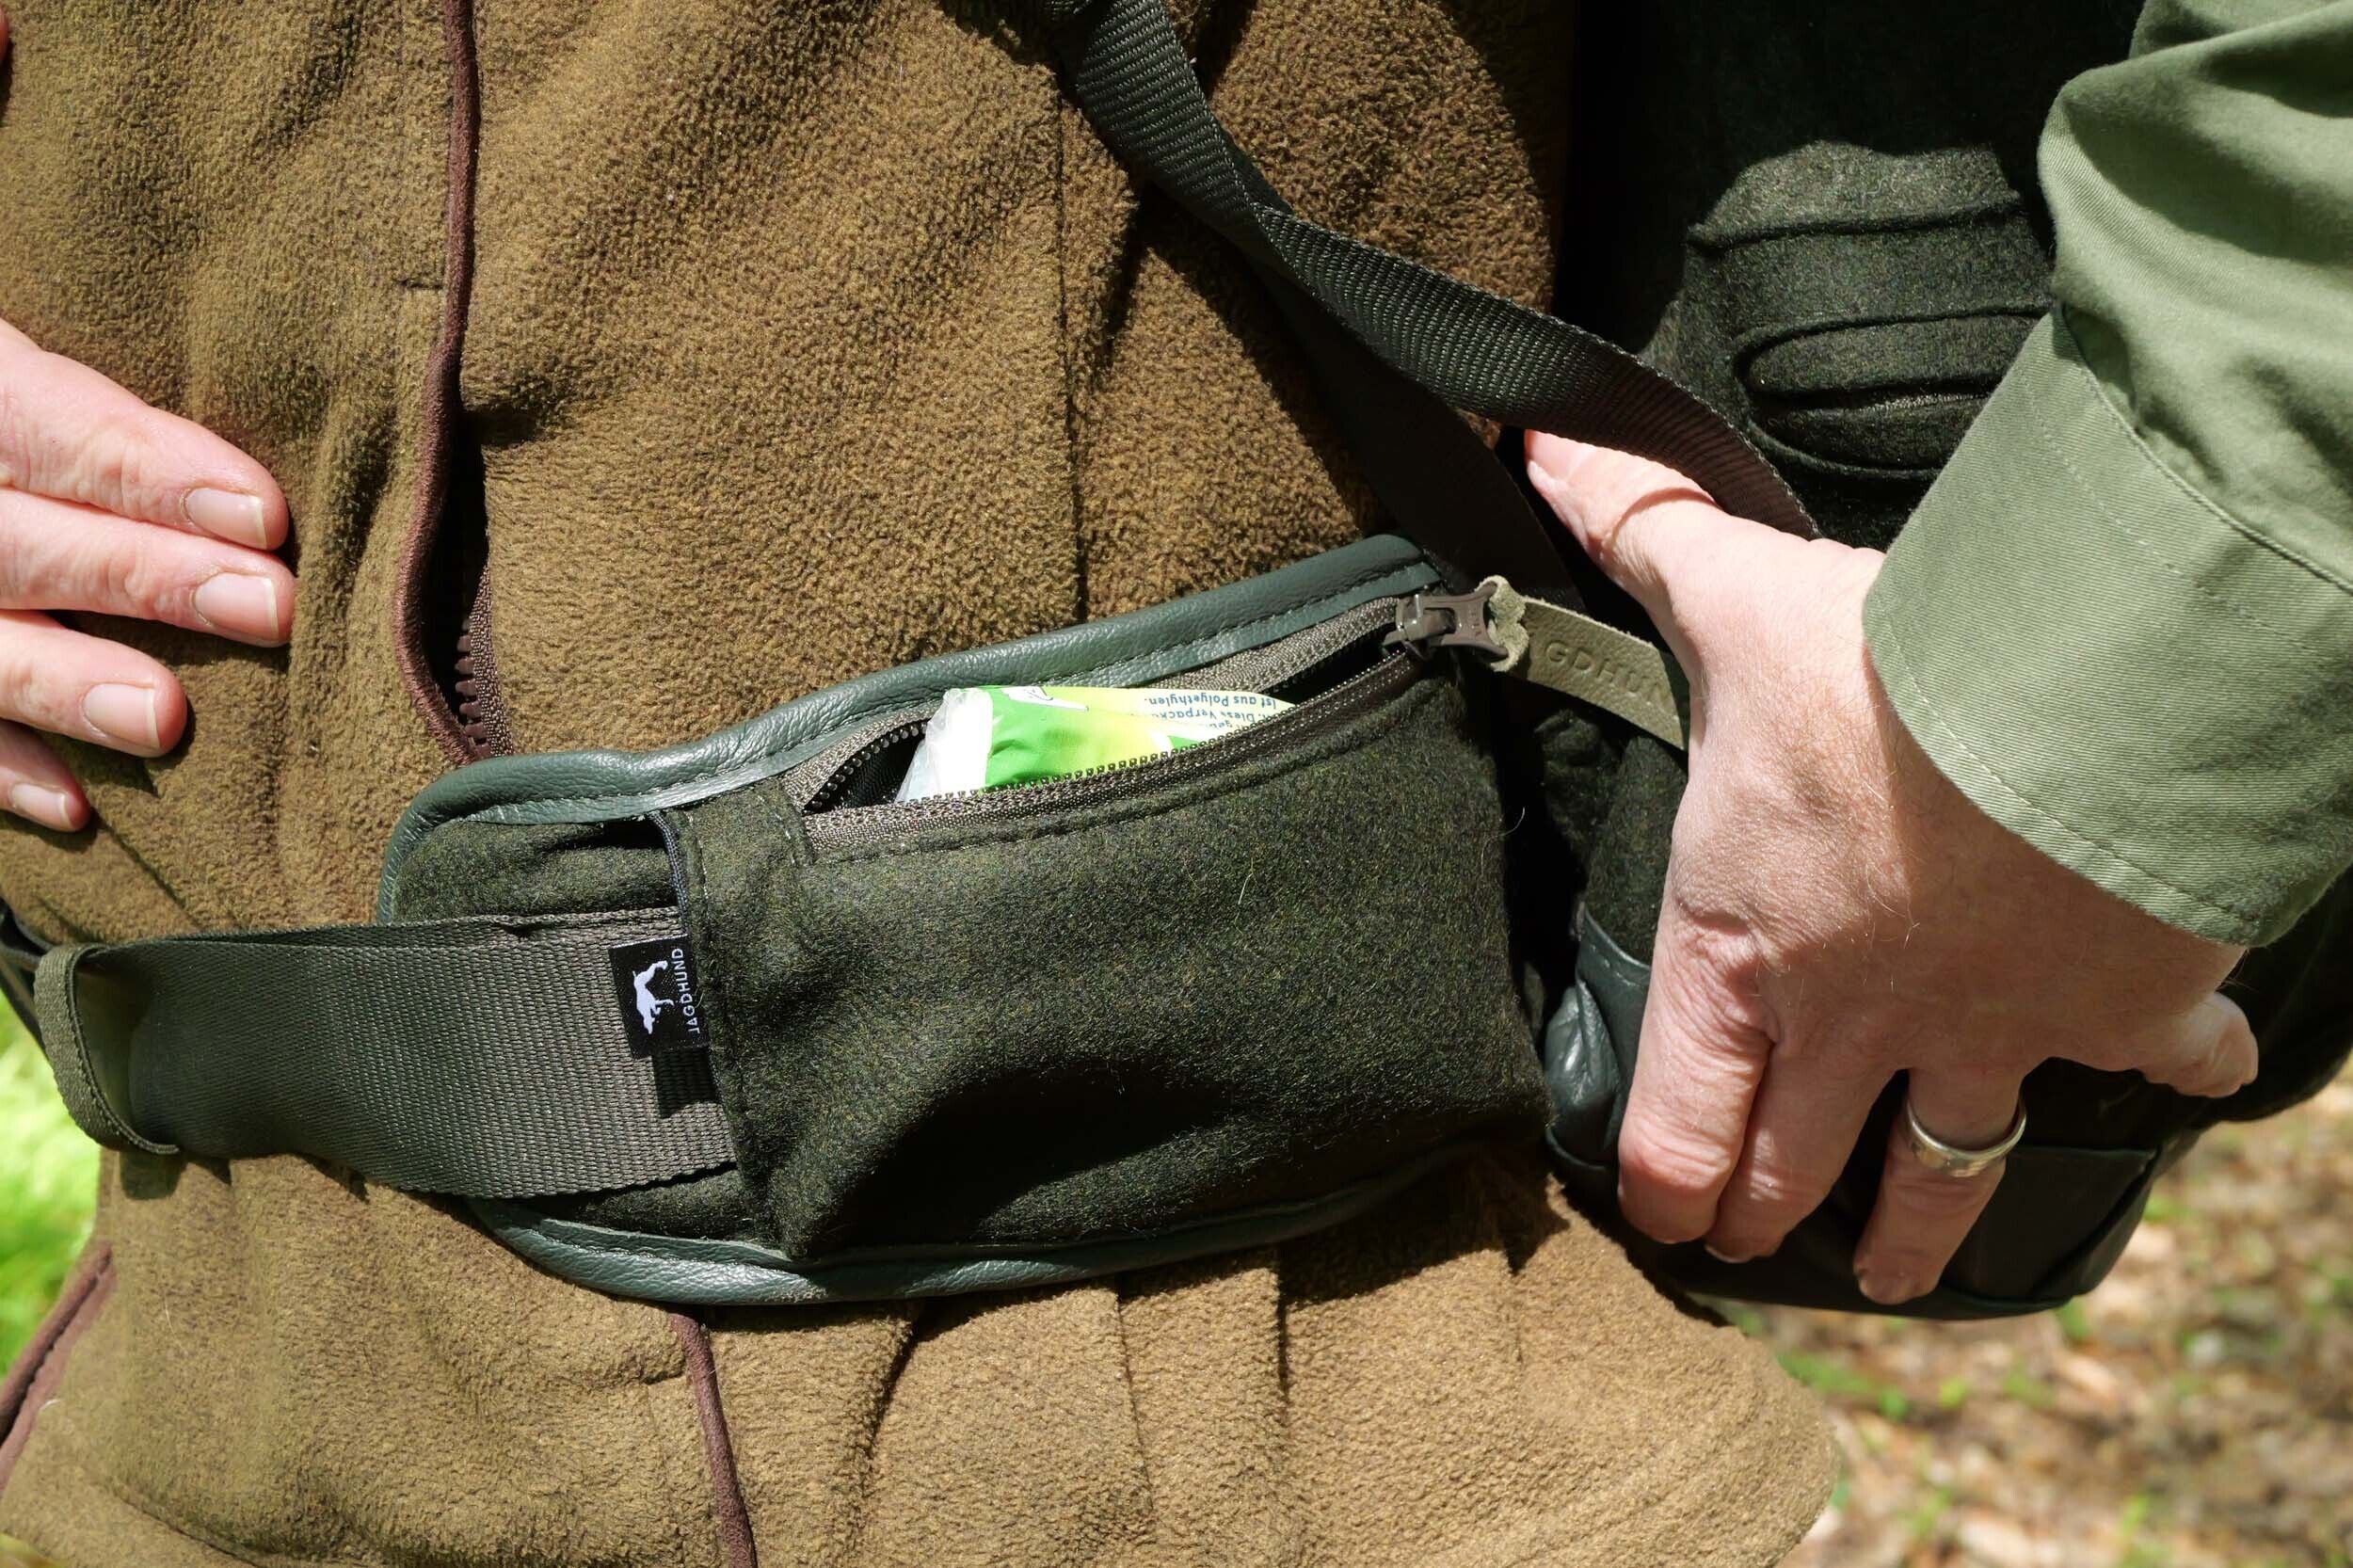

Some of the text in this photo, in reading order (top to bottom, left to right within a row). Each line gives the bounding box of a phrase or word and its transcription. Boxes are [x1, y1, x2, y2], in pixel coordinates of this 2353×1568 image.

[1144, 693, 1229, 707] Polyethylen.
[1234, 696, 1257, 705] aus
[671, 948, 700, 1033] JAGDHUND
